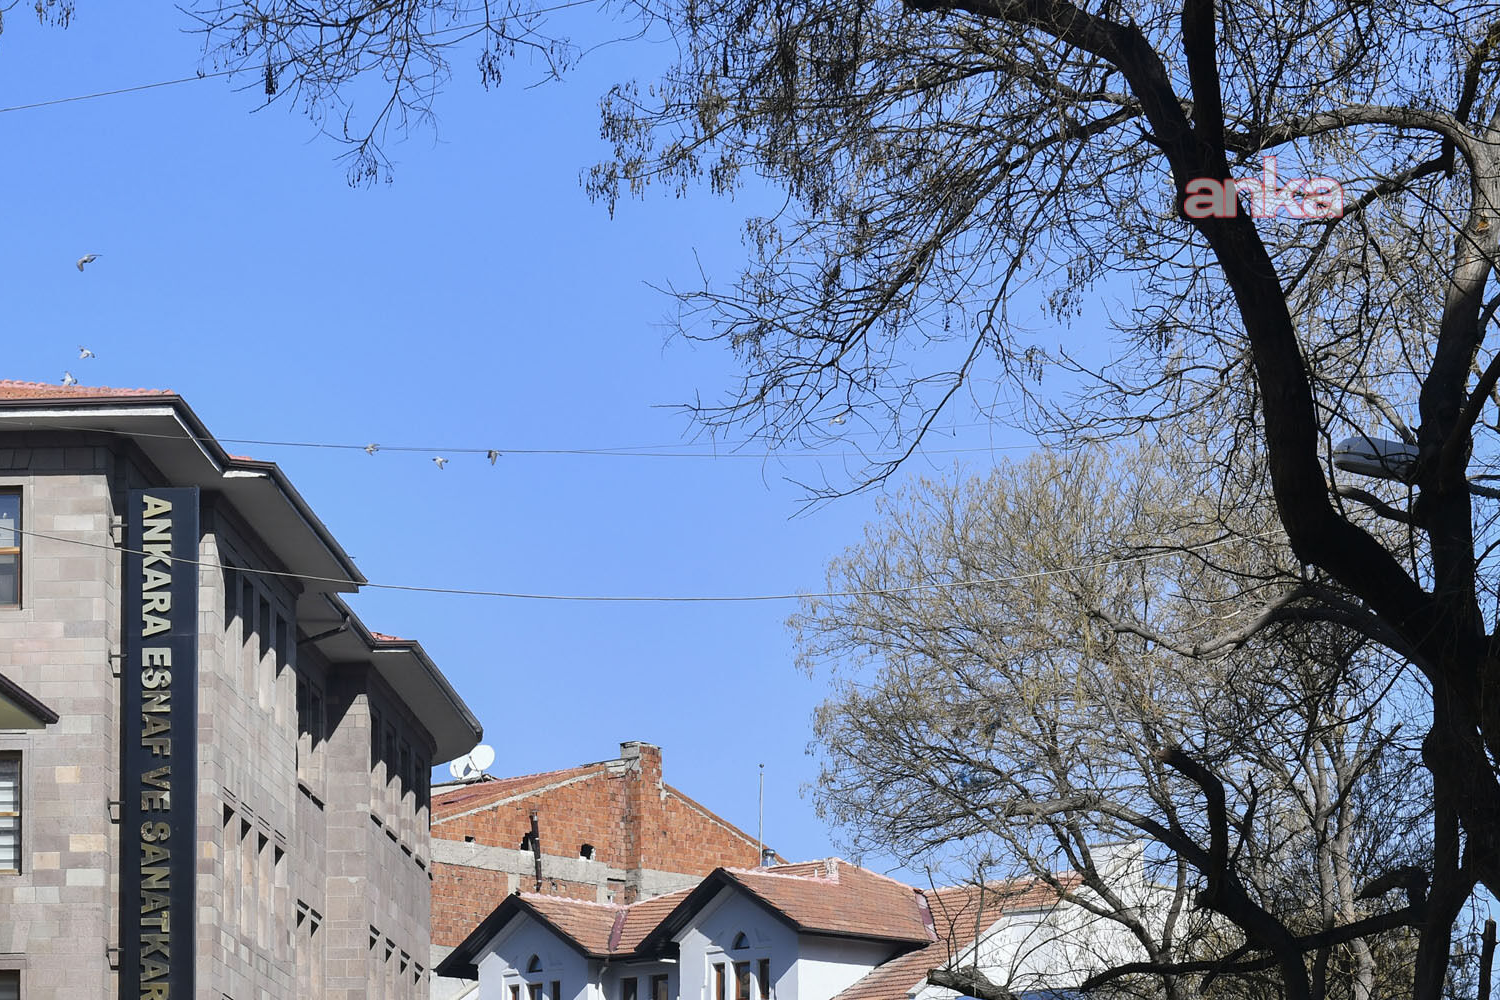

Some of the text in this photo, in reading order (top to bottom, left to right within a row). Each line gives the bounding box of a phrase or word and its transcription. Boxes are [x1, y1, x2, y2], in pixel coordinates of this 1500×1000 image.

[142, 495, 173, 637] ANKARA
[141, 647, 172, 756] ESNAF
[141, 765, 172, 812] VE
